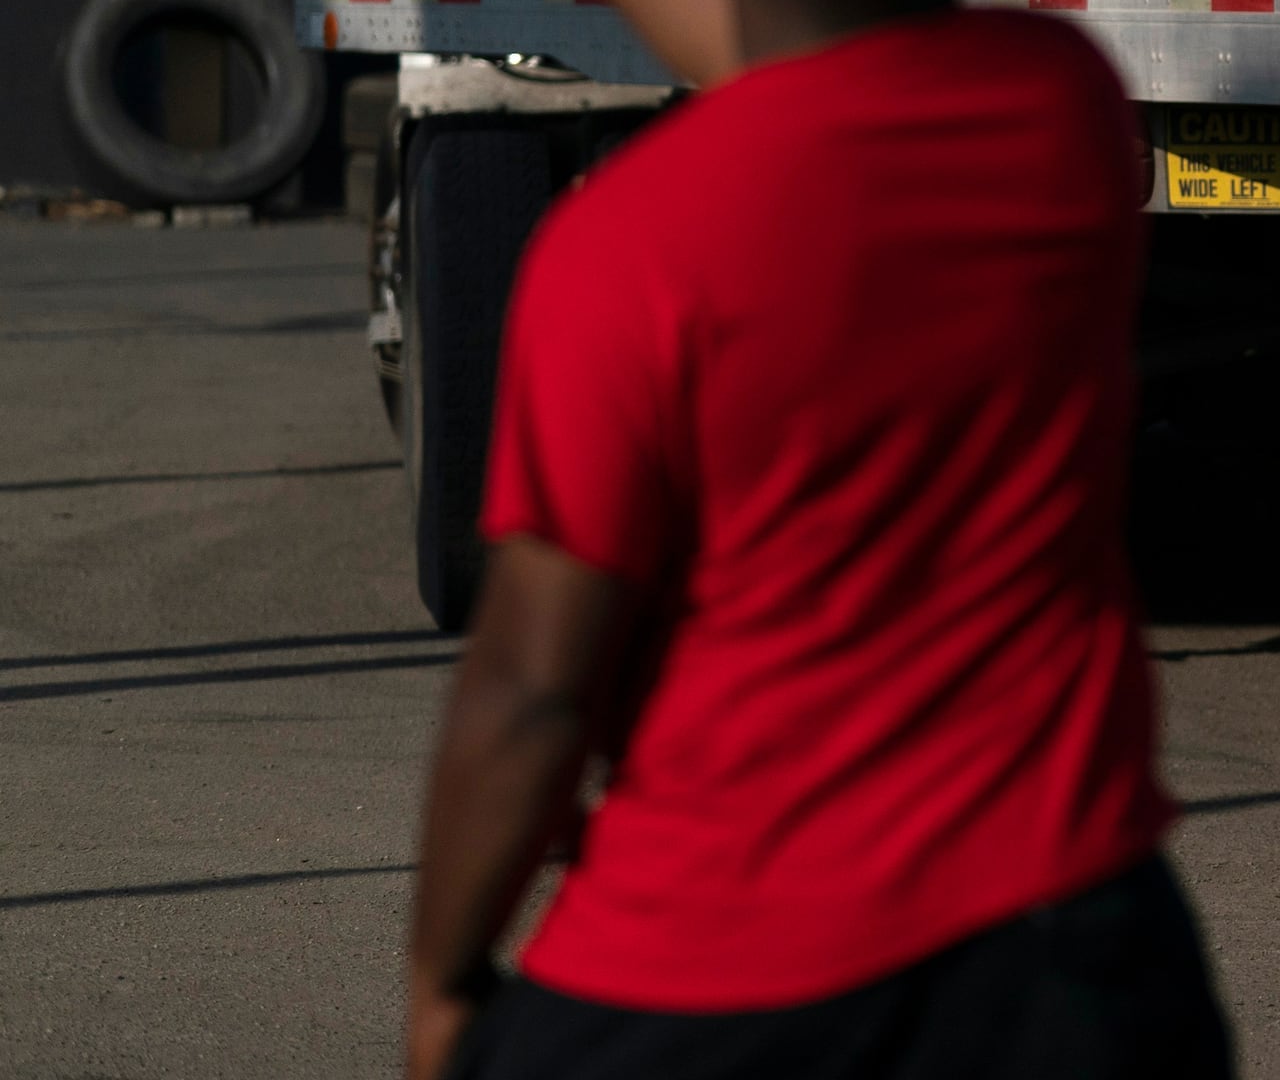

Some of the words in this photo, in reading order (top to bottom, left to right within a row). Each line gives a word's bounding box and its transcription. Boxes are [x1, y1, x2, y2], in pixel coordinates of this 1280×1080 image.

[1179, 152, 1210, 173] THIS
[1216, 152, 1276, 174] VEHICLE
[1178, 178, 1218, 198] WIDE
[1231, 178, 1269, 198] LEFT
